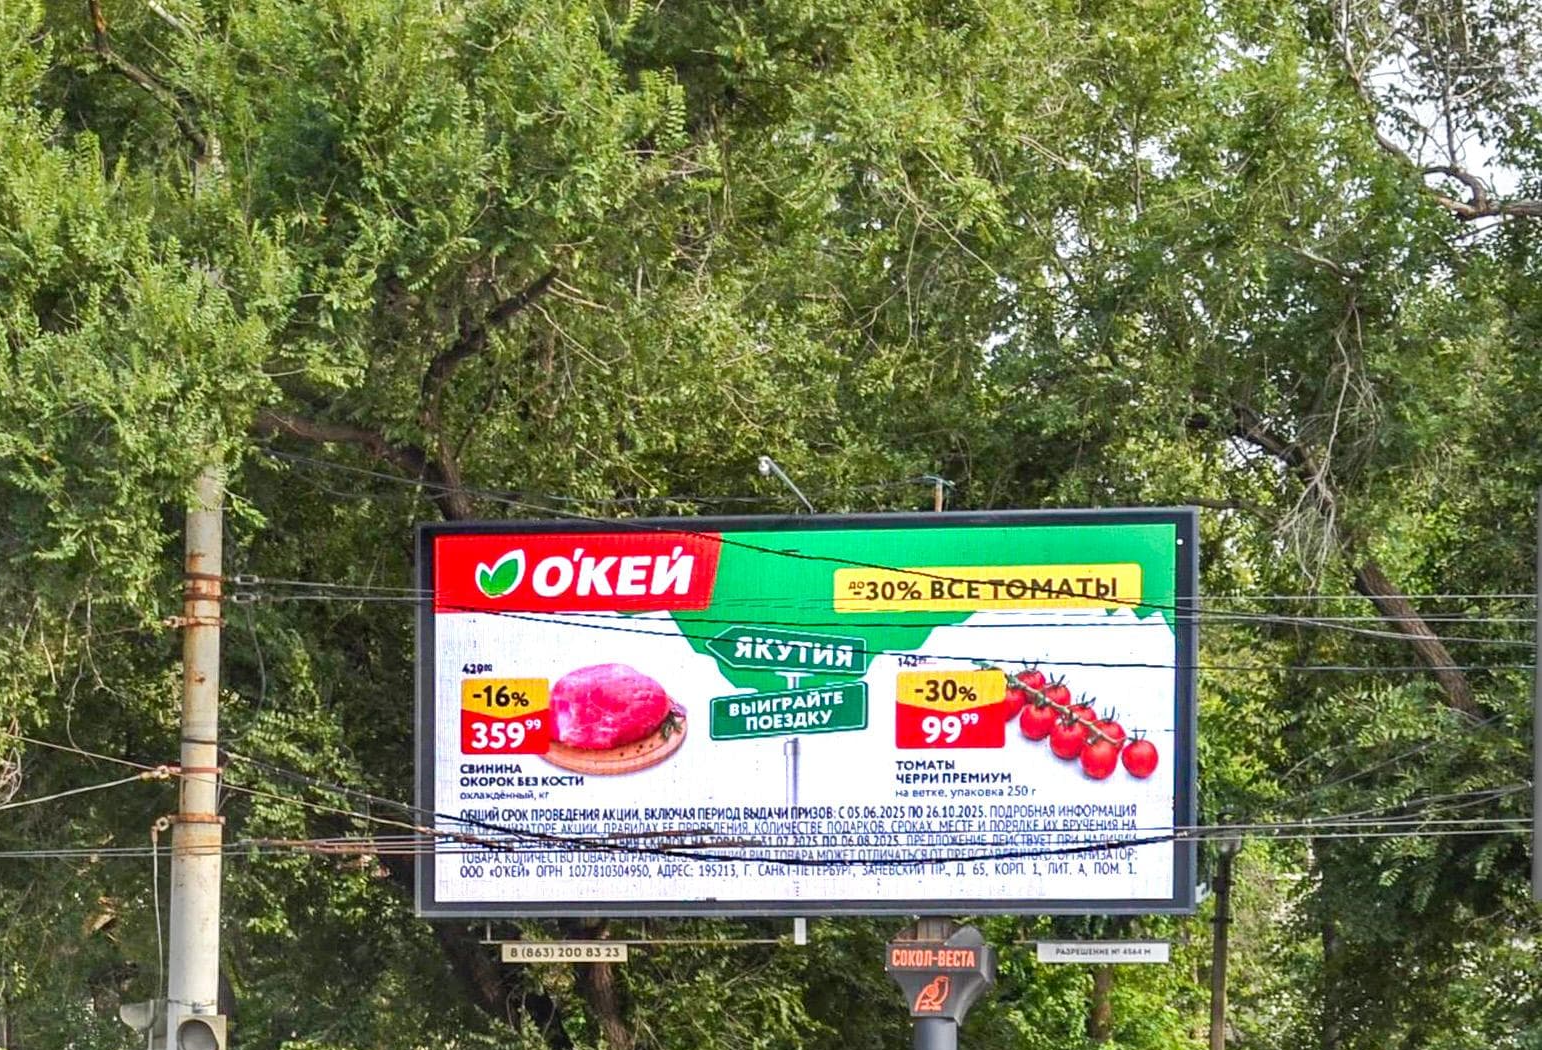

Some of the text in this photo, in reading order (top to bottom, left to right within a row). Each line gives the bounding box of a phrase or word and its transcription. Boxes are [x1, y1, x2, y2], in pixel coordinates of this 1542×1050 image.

[531, 543, 695, 597] О'КЕЙ
[853, 581, 922, 601] -30%
[930, 580, 980, 600] ВСЕ
[990, 577, 1118, 600] ТОМАТЫ
[734, 636, 854, 668] ЯКУТИЯ
[473, 685, 529, 708] -16%
[915, 679, 977, 702] -30%
[728, 691, 844, 717] ВЫИГРАЙТЕ
[745, 709, 833, 732] ПОЕЗДКУ
[460, 763, 523, 775] СВИНИНА
[896, 760, 955, 771] ТОМАТЫ
[460, 775, 584, 787] ОКОРОК БЕЗ КОСТИ
[896, 772, 1012, 784] ЧЕРРИ ПРЕМИУМ
[896, 788, 909, 797] на
[912, 788, 948, 799] ветке,
[950, 787, 1005, 799] упаковка
[1007, 785, 1029, 797] 250
[460, 808, 499, 822] ОБЩИЙ
[502, 808, 528, 820] СРОК
[531, 808, 600, 822] ПРОВЕДЕНИЯ
[602, 808, 642, 821] АКЦИИ,
[644, 808, 695, 820] ВКЛЮЧАЯ
[698, 807, 741, 821] ПЕРИОД
[743, 807, 788, 820] ВЫДАЧИ
[847, 806, 905, 818] 05.06.2025
[908, 806, 923, 818] ПО
[990, 805, 1056, 819] ПОДРОБНАЯ
[1058, 805, 1137, 818] ИНФОРМАЦИЯ
[754, 821, 823, 833] КОЛИЧЕСТВЕ
[939, 820, 973, 832] МЕСТЕ
[978, 820, 986, 832] И
[990, 820, 1039, 833] ПОРЯДКЕ
[1044, 820, 1058, 832] ИХ
[1062, 819, 1118, 831] ВРУЧЕНИЯ
[1121, 819, 1137, 831] НА
[822, 835, 837, 847] ПО
[817, 850, 856, 862] МОЖЕТ
[858, 849, 927, 861] ОТЛИЧАТЬСЯ
[930, 849, 943, 861] ОТ
[460, 866, 484, 878] ООО
[536, 865, 562, 877] ОГРН
[699, 865, 739, 878] 195213,
[862, 863, 925, 876] ЗАНЕВСКИЙ
[510, 947, 620, 959] 8 (863) 200 83 23
[892, 948, 976, 968] СОКОЛ-ВЕСТА
[1056, 948, 1109, 956] РАЗРЕШЕНИЕ
